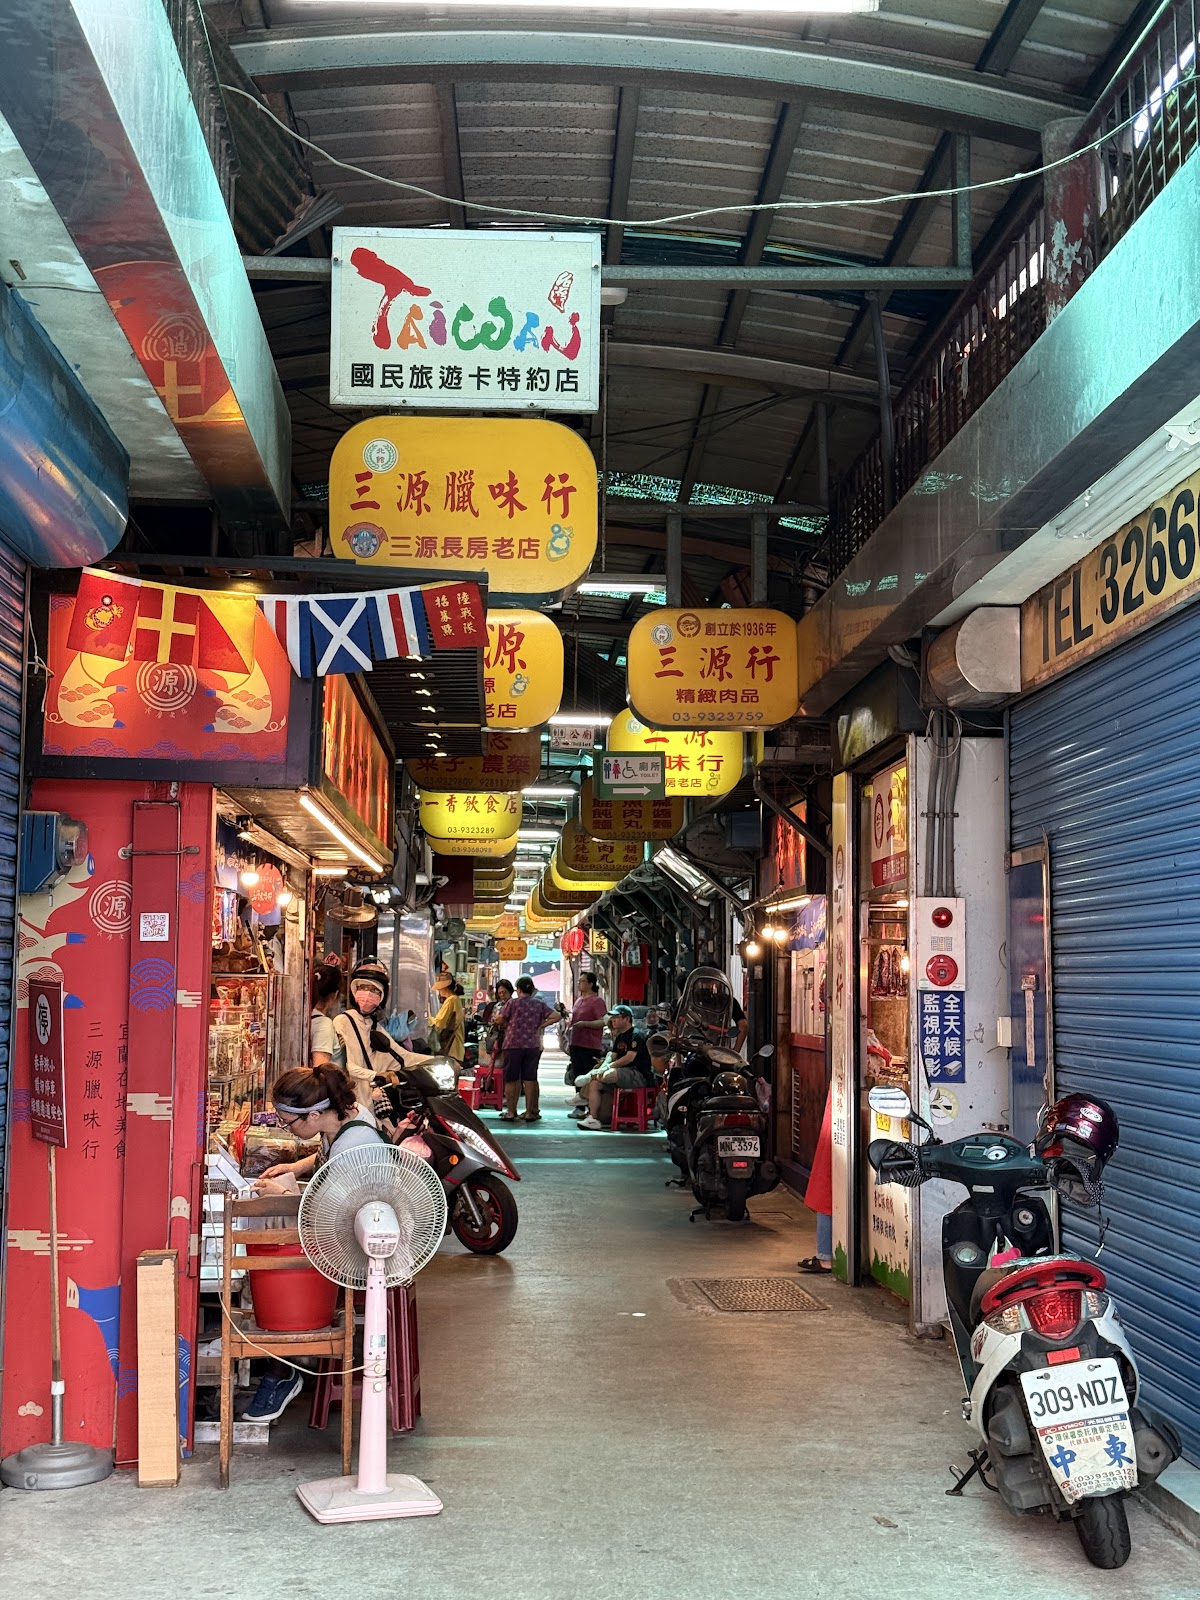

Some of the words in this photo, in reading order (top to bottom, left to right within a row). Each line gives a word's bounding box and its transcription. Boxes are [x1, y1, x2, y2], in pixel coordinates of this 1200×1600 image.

[350, 363, 579, 393] 國民旅遊卡特約店
[350, 470, 578, 519] 三源臘味行
[389, 536, 541, 560] 三源長房老店
[1039, 566, 1093, 665] TEL
[1099, 487, 1200, 626] 3266
[456, 592, 478, 634] 陸戰隊
[704, 622, 777, 637] 創立於1936年
[654, 645, 781, 682] 三源行
[152, 669, 179, 696] 源
[676, 689, 760, 703] 精緻肉品
[673, 712, 764, 722] 03-9323759
[570, 729, 592, 740] 公廁
[639, 762, 660, 772] 廁所
[425, 794, 517, 814] 一香飲食店
[447, 826, 496, 834] 03-9323289
[104, 896, 127, 920] 源
[923, 993, 942, 1077] 監視錄影
[943, 993, 962, 1057] 全天候
[80, 1021, 104, 1160] 三源臘味行
[720, 1141, 759, 1152] MNC-3396
[1058, 1421, 1085, 1431] KYMCO
